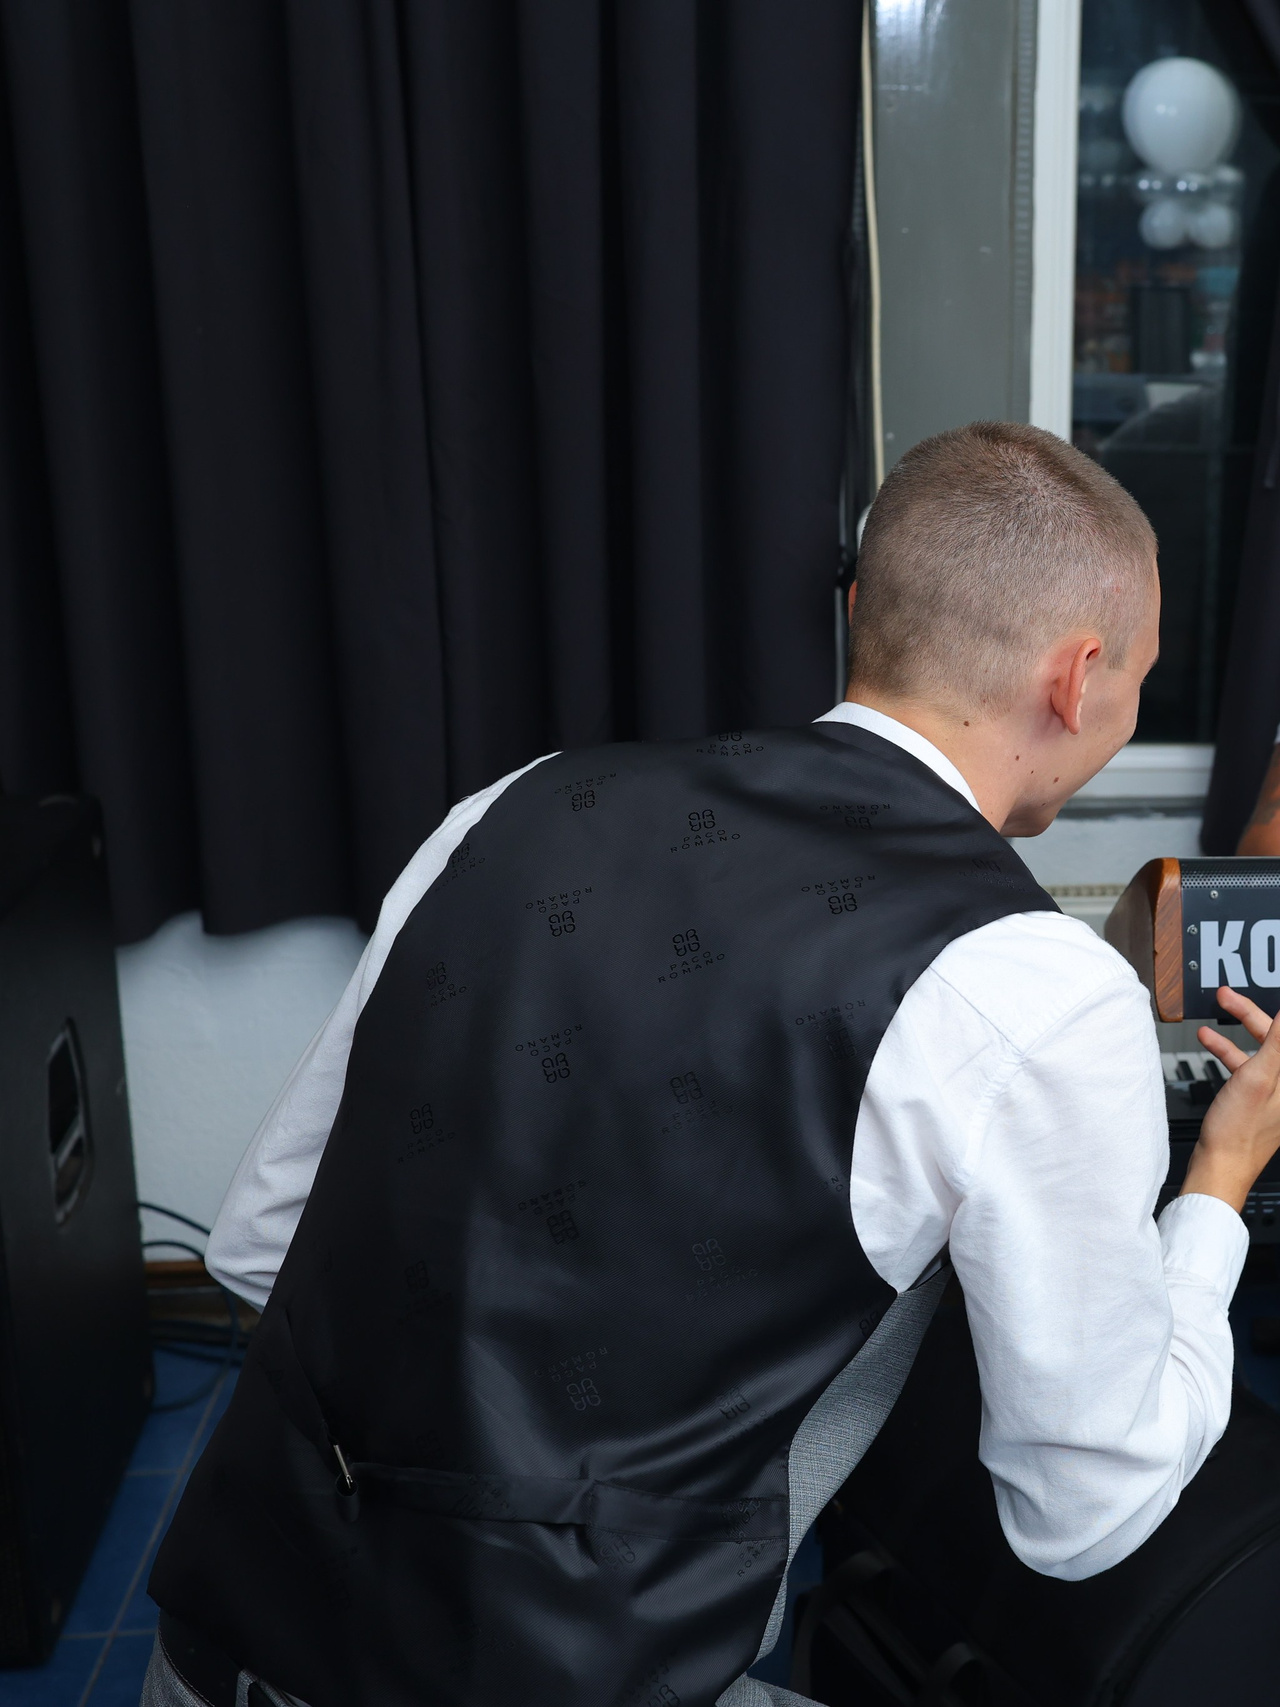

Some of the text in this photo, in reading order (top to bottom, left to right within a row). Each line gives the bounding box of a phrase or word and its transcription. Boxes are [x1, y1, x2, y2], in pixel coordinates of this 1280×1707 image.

[670, 833, 741, 853] ROMANO
[682, 829, 726, 844] PACO
[800, 875, 876, 893] ROMANO
[816, 882, 863, 896] PACO
[525, 886, 594, 910] ROMANO
[538, 897, 581, 914] PACO
[658, 952, 726, 984] ROMANO
[668, 950, 712, 972] PACO
[794, 999, 867, 1026] ROMANO
[514, 1023, 583, 1052] ROMANO
[529, 1037, 573, 1057] PACO
